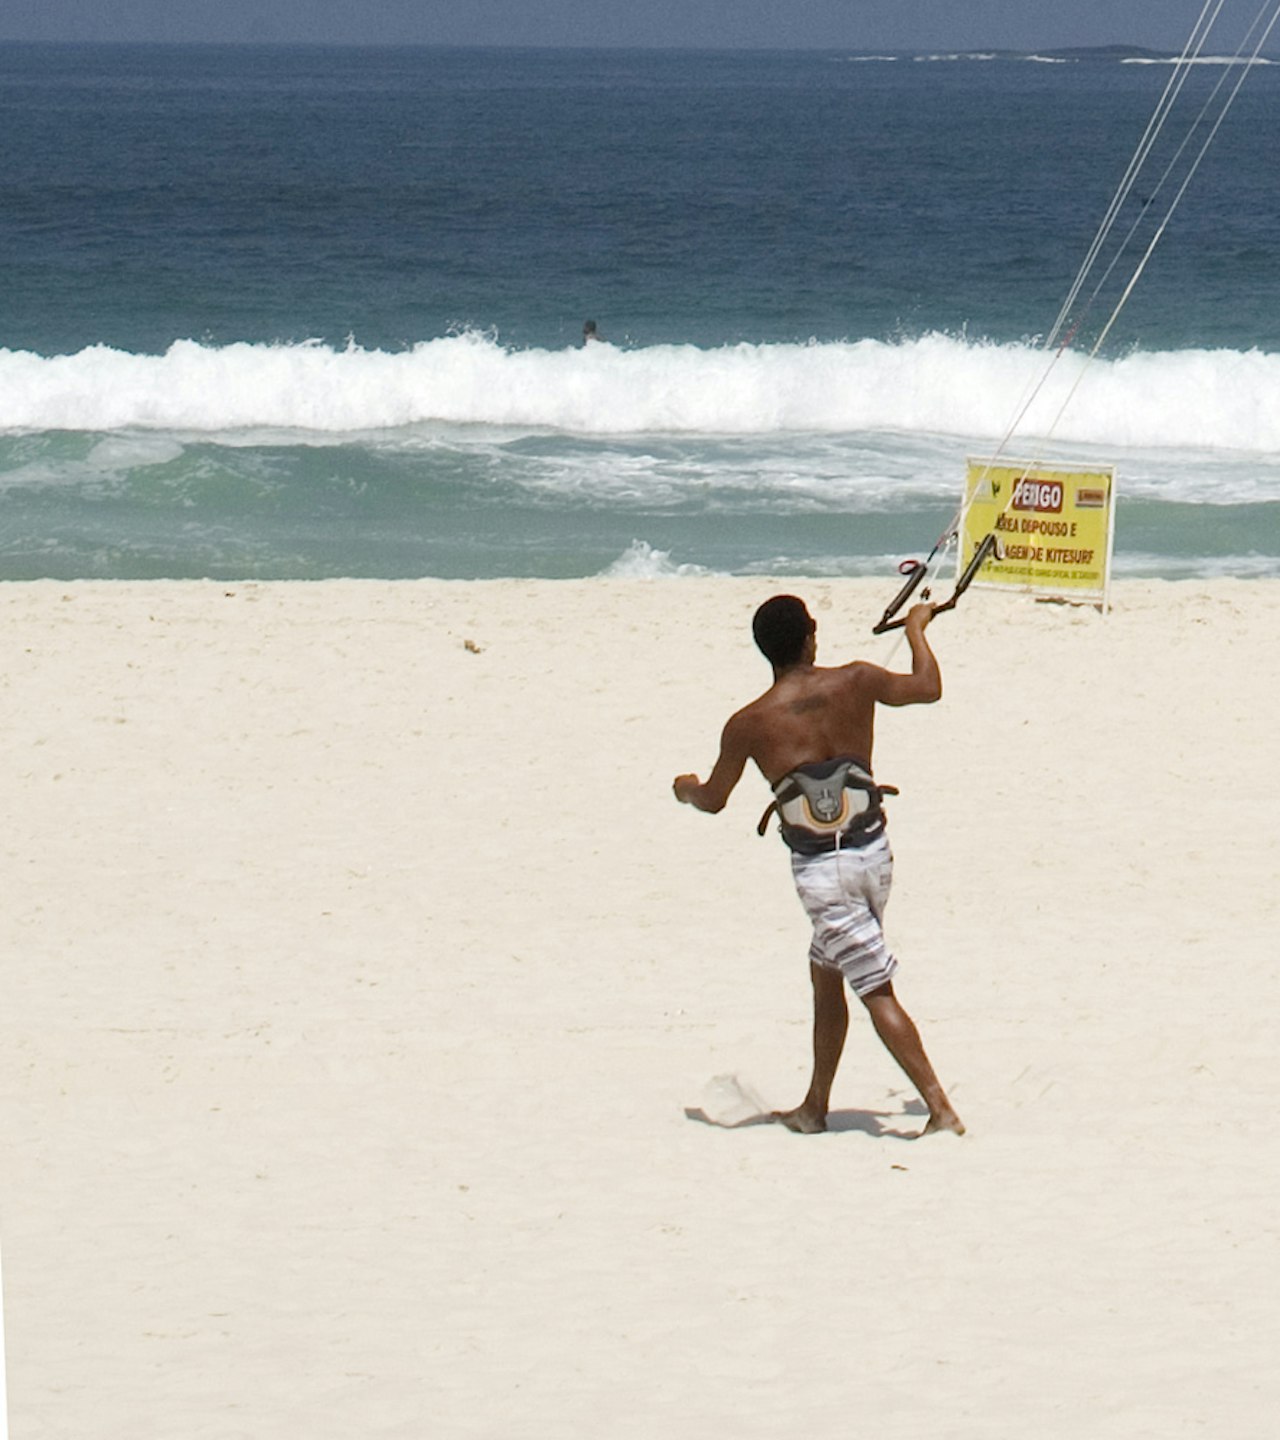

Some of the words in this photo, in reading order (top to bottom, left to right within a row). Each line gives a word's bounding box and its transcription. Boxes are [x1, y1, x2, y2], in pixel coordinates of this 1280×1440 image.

[1014, 483, 1062, 508] PERIGO
[1033, 519, 1068, 537] POUSO
[1070, 523, 1077, 537] E
[1046, 548, 1094, 565] KITESURF
